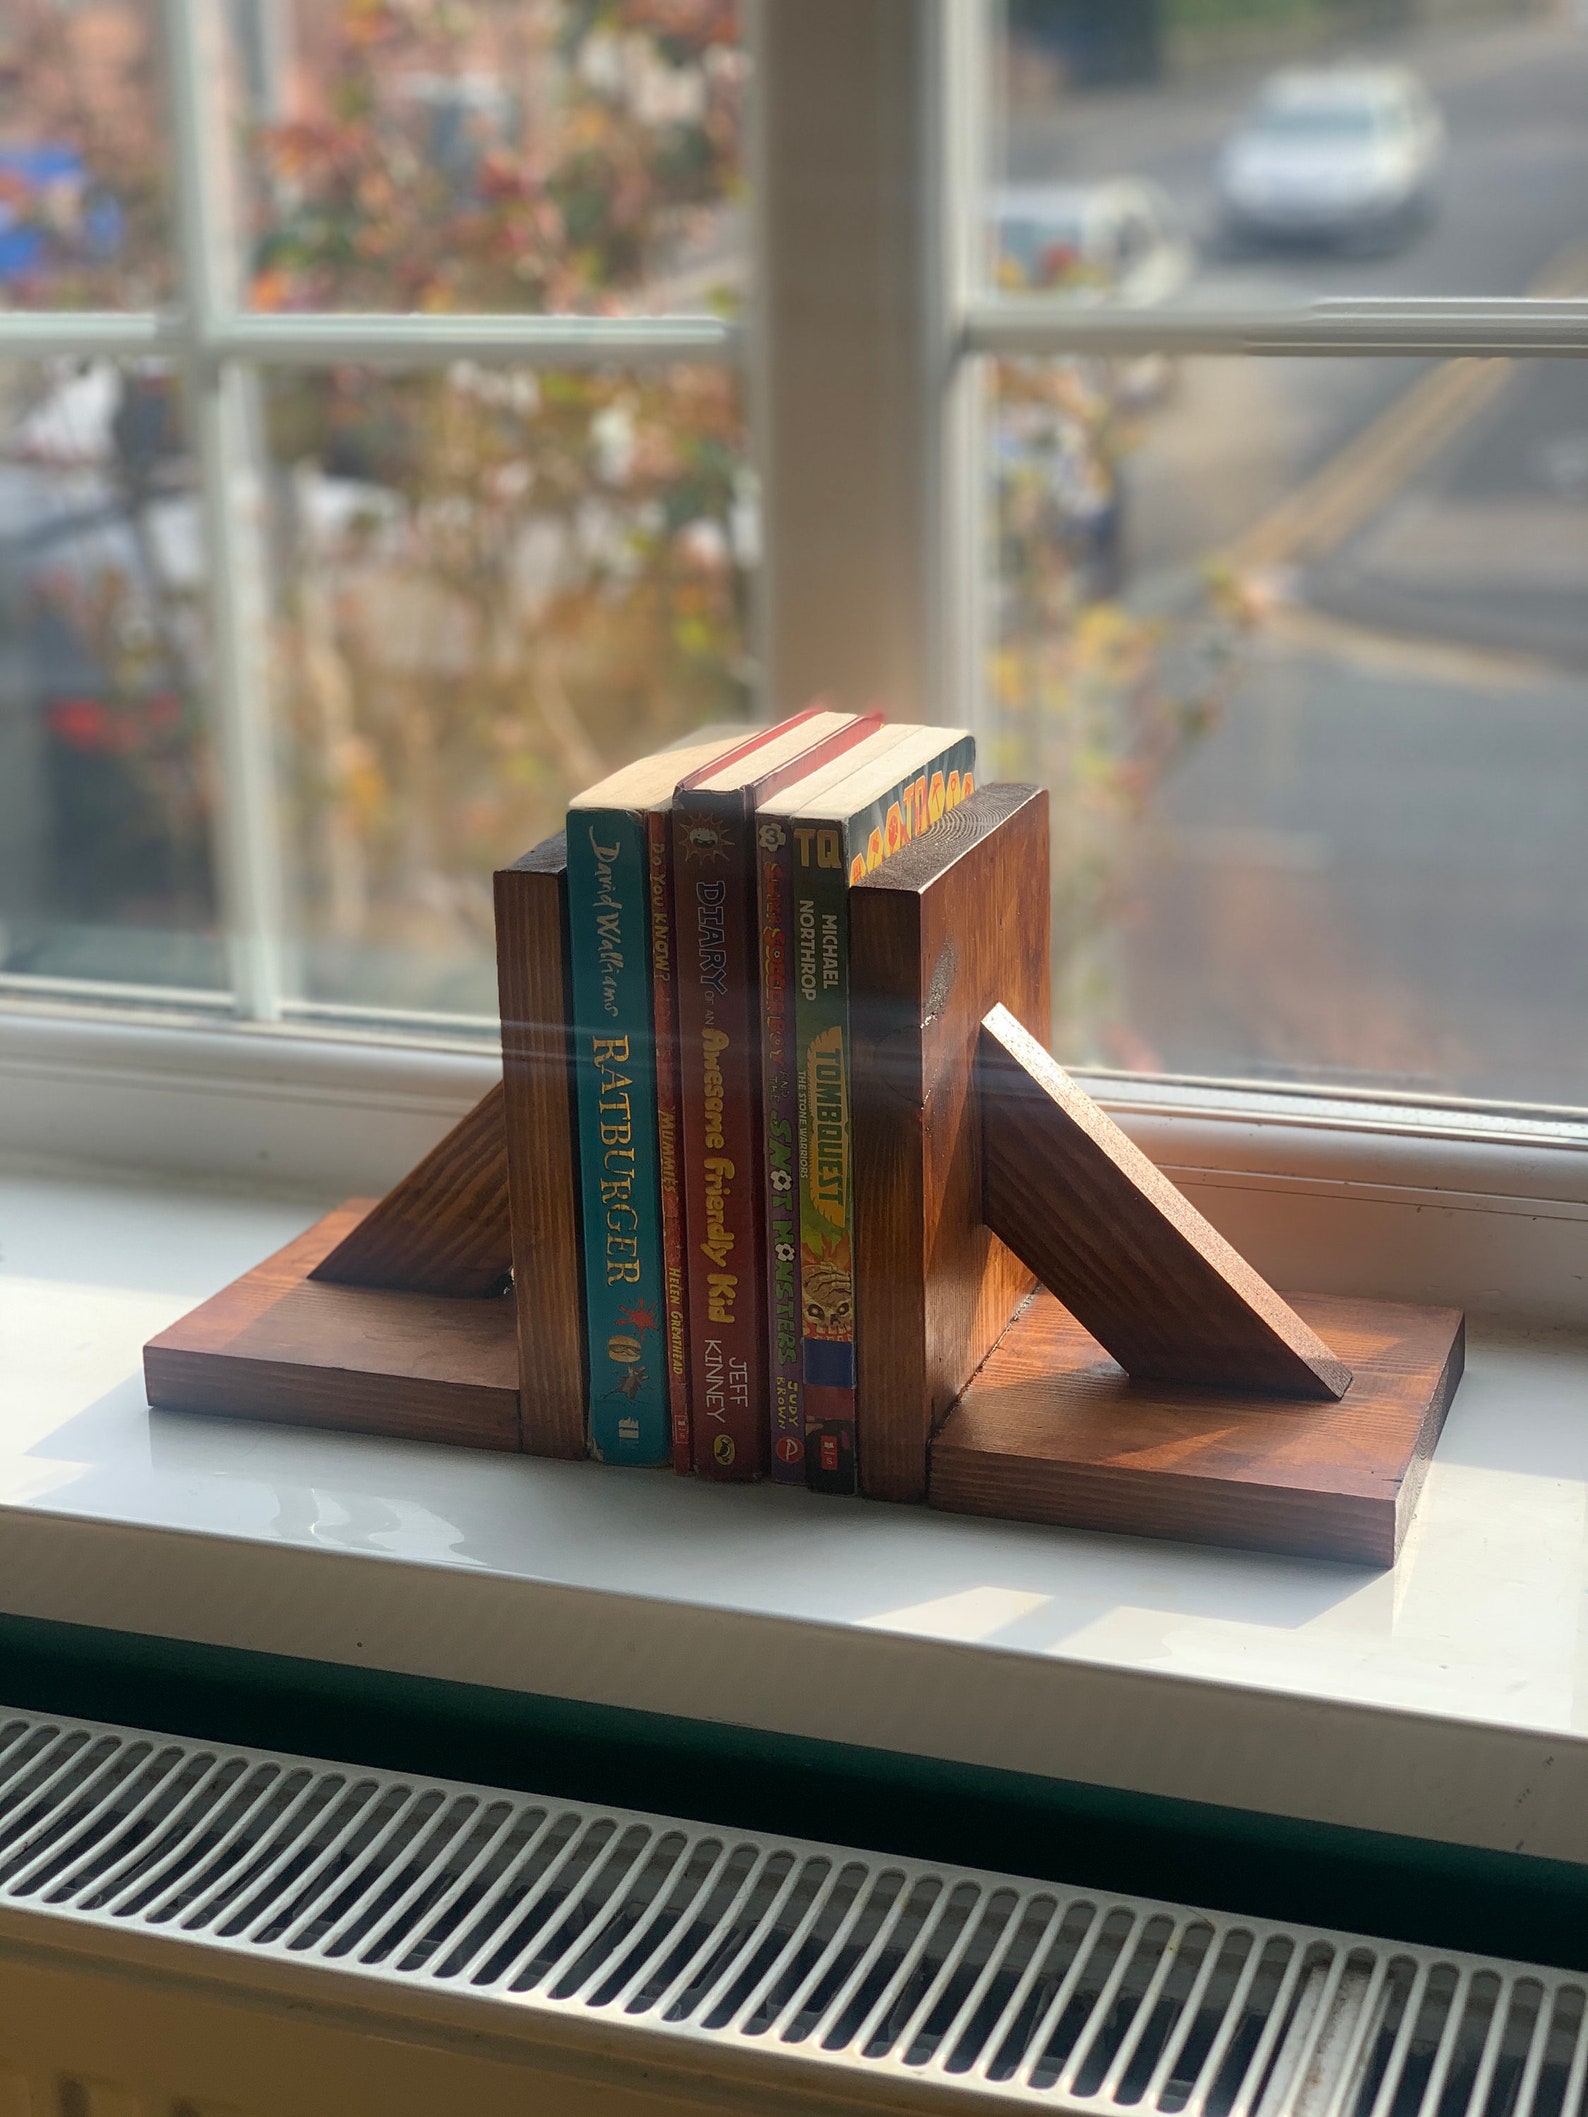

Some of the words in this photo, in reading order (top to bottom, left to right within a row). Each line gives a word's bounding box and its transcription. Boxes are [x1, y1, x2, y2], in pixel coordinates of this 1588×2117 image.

[766, 828, 779, 845] 3
[794, 829, 841, 869] TQ
[589, 825, 622, 909] David
[597, 911, 623, 1017] Walliams
[696, 881, 728, 995] DIARY
[800, 900, 817, 1001] NORTHROP
[822, 914, 839, 989] MICHAEL
[704, 1010, 714, 1025] AN
[767, 1015, 785, 1066] BOY
[701, 1028, 730, 1149] Awesome
[798, 1071, 806, 1090] THE
[799, 1091, 807, 1126] STONE
[660, 1110, 678, 1194] MUMMIES
[800, 1128, 809, 1179] WARRIORS
[815, 1048, 843, 1206] TOMBQUEST
[593, 1035, 640, 1286] RATBURGER
[700, 1157, 735, 1267] Friendly
[668, 1267, 682, 1305] HELEN
[707, 1273, 738, 1323] Kid
[670, 1311, 684, 1375] GREATHEAD
[704, 1339, 726, 1423] KINNEY
[729, 1357, 748, 1407] JEFF
[777, 1376, 786, 1430] BROWN
[788, 1381, 798, 1427] JUDY
